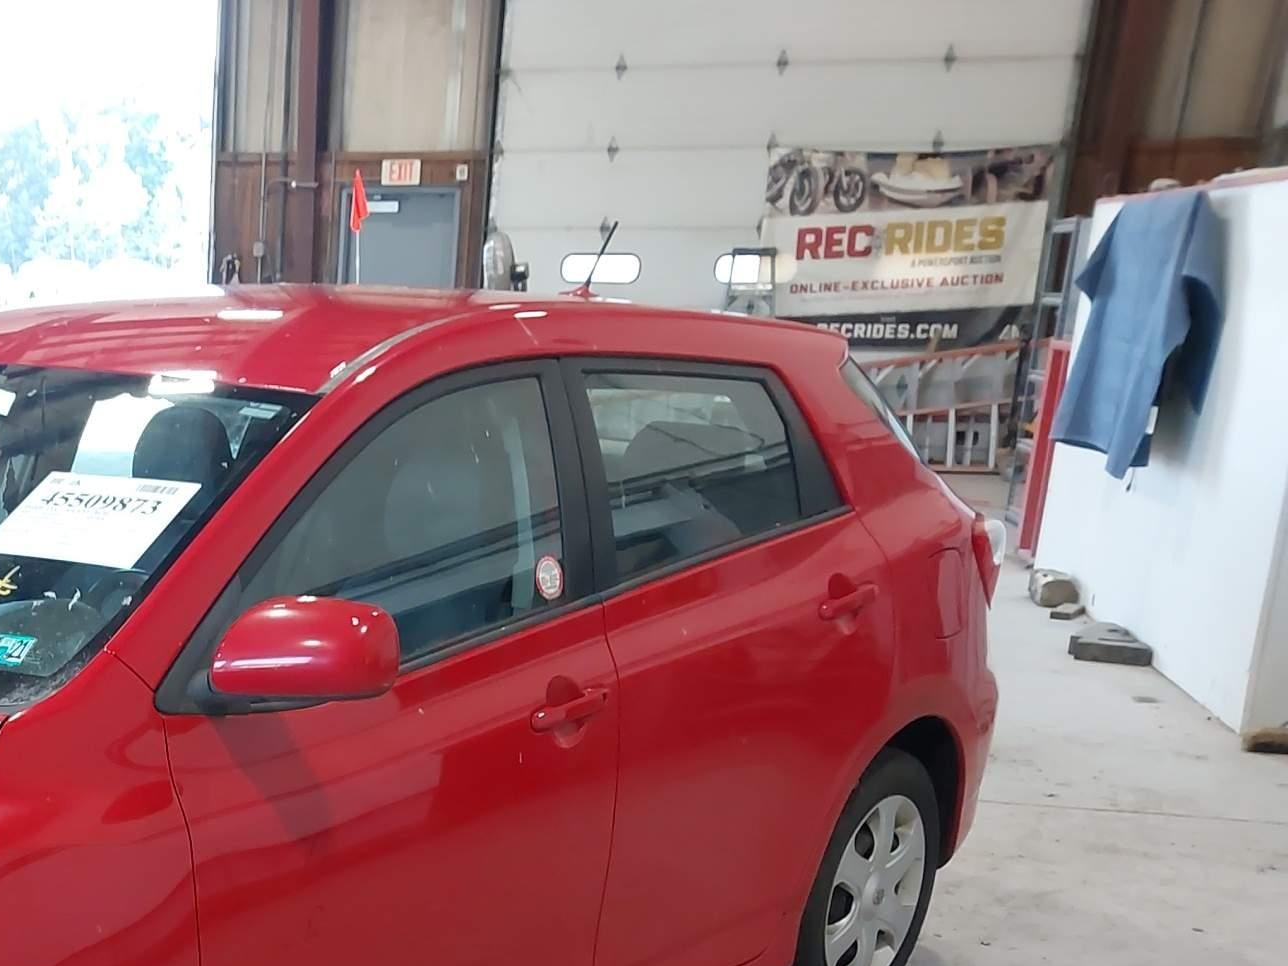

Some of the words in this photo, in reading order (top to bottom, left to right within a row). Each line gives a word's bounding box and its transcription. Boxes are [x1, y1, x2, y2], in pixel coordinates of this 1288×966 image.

[795, 224, 875, 261] REC
[884, 216, 1006, 256] RIDES
[790, 277, 934, 295] ONLINE-EXCLUSIVE
[940, 272, 1004, 287] AUCTION
[41, 491, 163, 514] 45509873
